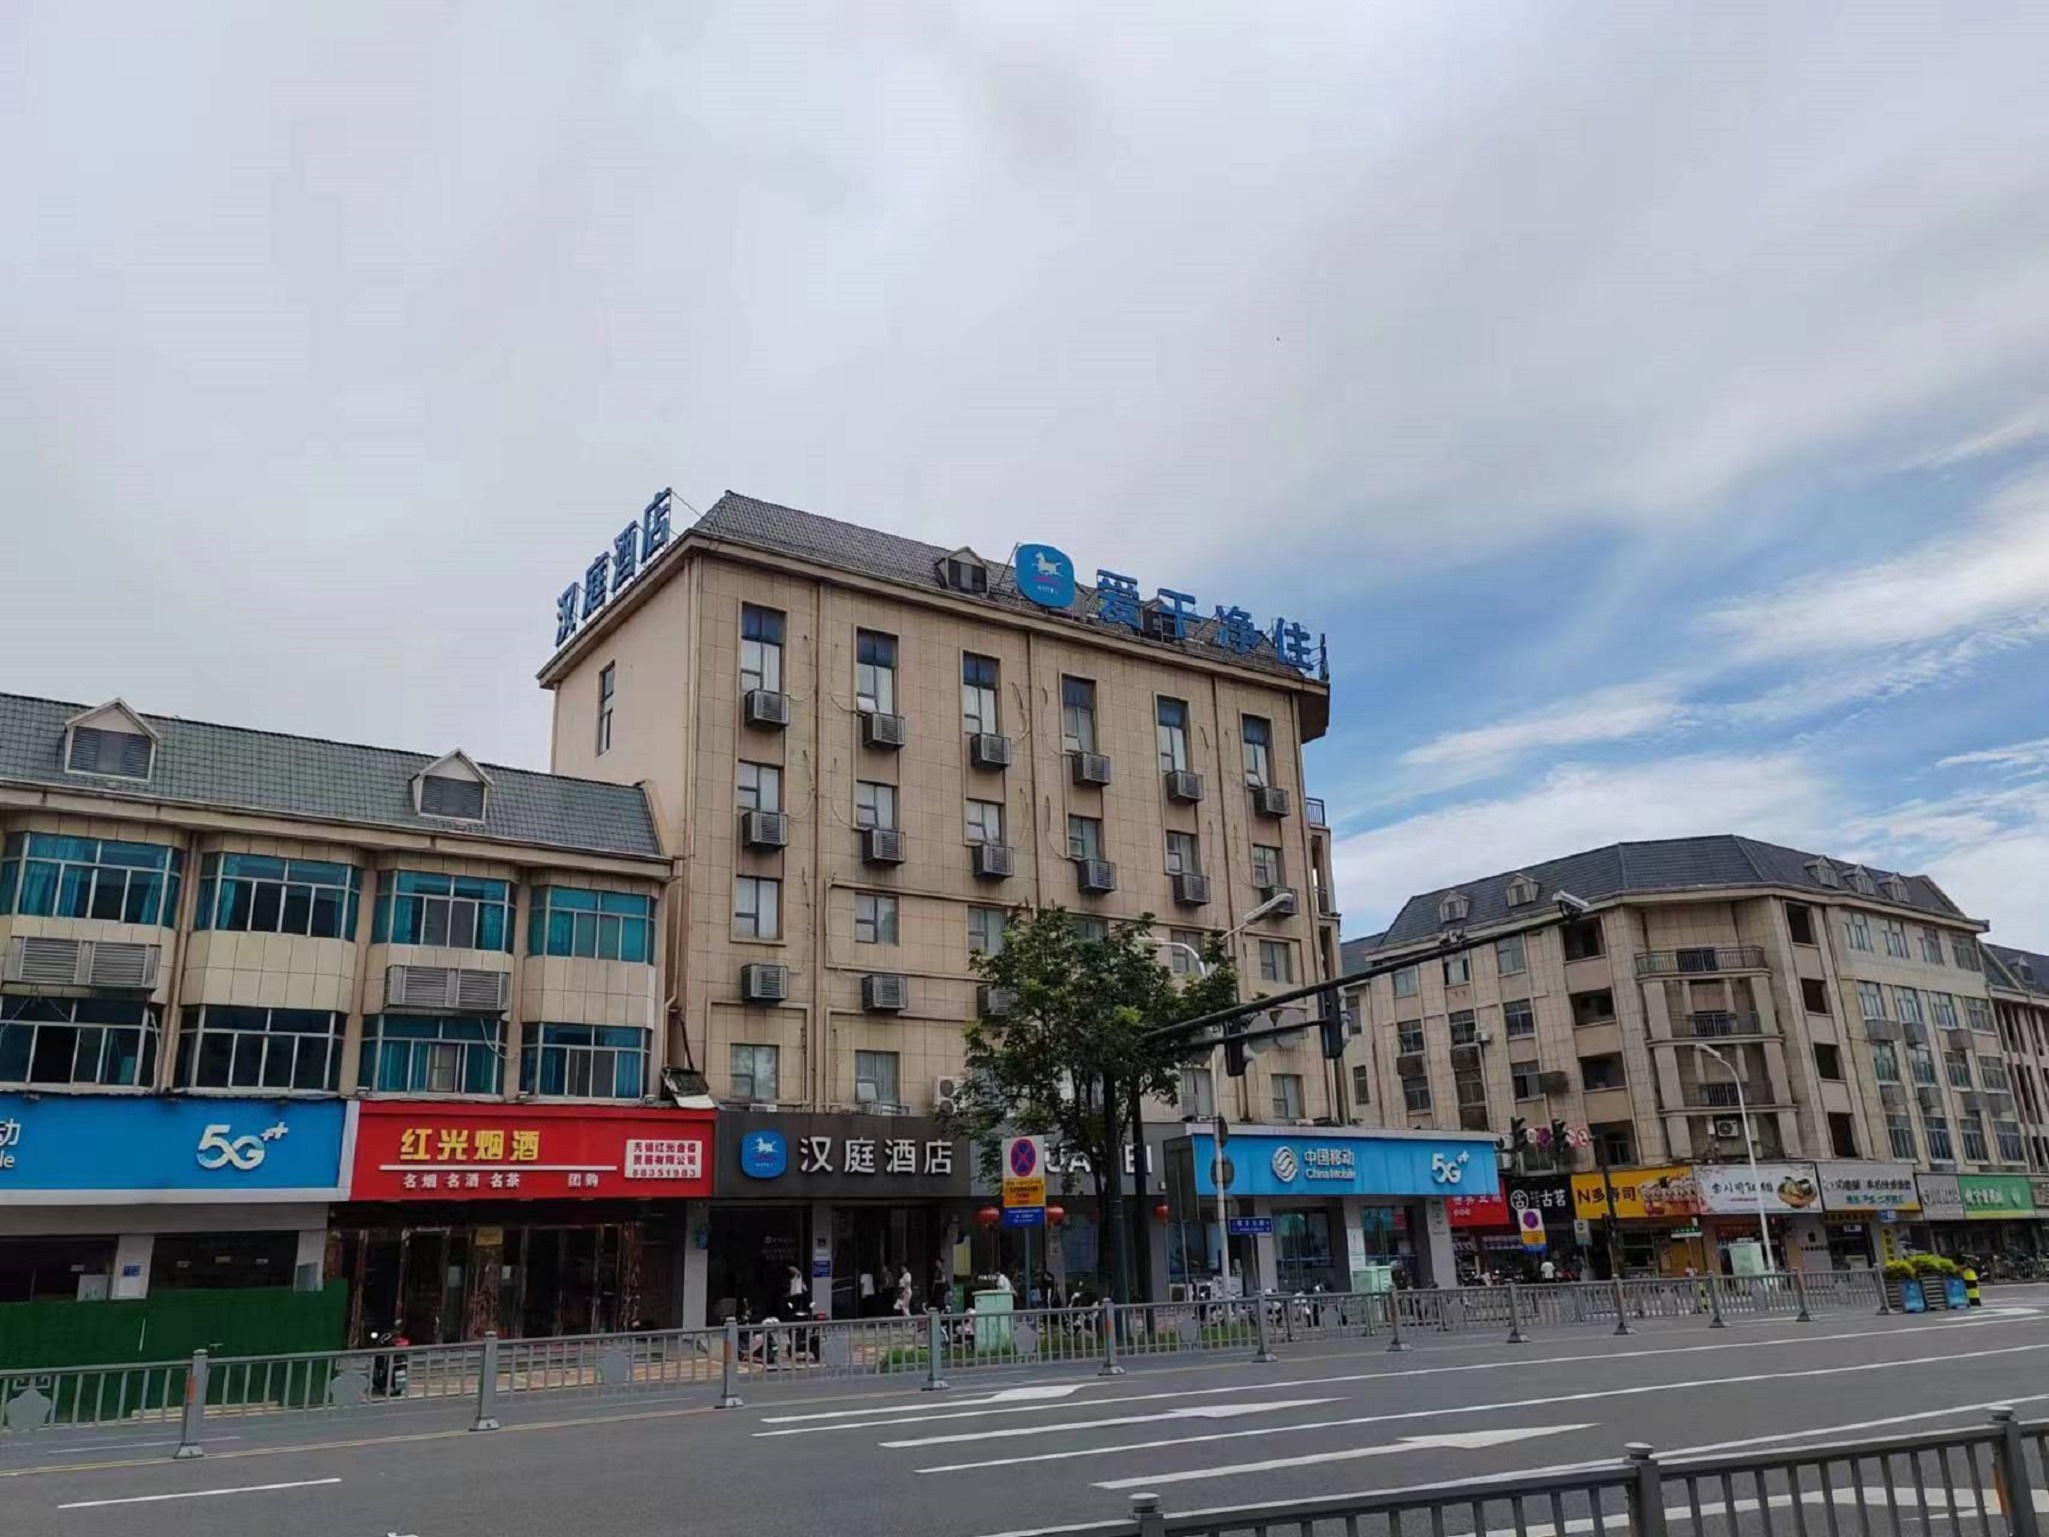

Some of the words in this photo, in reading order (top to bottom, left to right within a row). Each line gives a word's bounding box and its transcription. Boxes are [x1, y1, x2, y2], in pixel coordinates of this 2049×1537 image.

[555, 487, 672, 648] 汉庭酒店
[400, 1128, 540, 1161] 红光烟酒
[799, 1136, 953, 1174] 汉庭酒店
[1304, 1148, 1355, 1166] 中国移动
[567, 1172, 599, 1187] 团购
